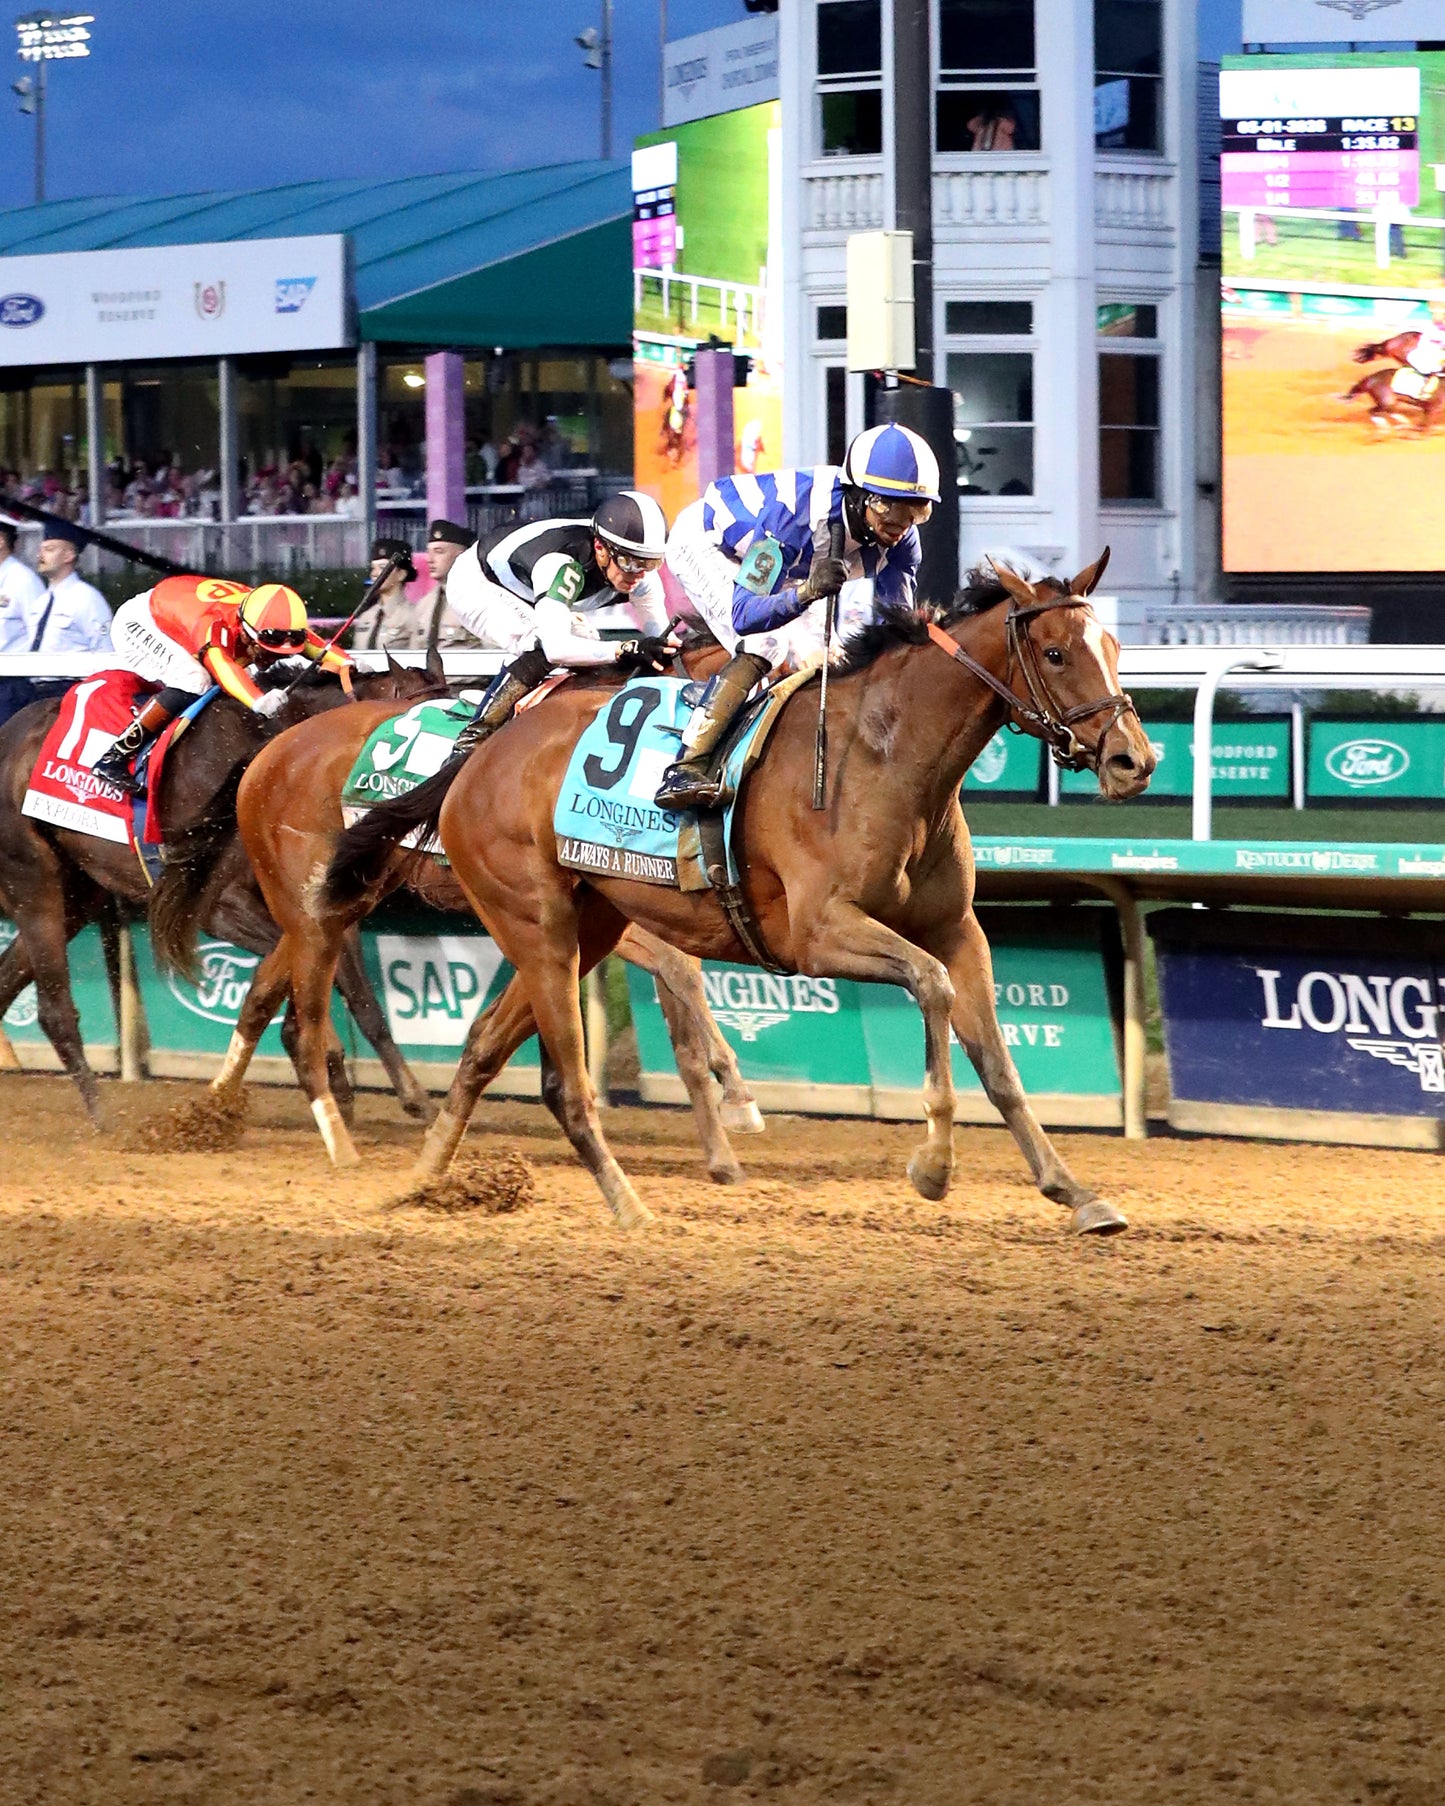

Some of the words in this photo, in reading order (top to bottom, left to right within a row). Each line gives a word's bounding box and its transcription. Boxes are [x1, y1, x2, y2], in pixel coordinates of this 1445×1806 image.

[1341, 118, 1389, 133] RACE
[1390, 117, 1415, 131] 13
[1256, 138, 1297, 151] MILE
[557, 566, 581, 600] 5
[746, 551, 776, 586] 9
[56, 679, 107, 760] 1
[371, 699, 460, 771] 5
[583, 686, 662, 790] 9
[1188, 745, 1278, 759] ODFORD
[1211, 766, 1270, 780] ESERVE
[1340, 745, 1394, 776] Ford
[41, 760, 124, 803] LONGINES
[354, 773, 421, 795] LONG
[32, 796, 100, 831] EXPLORA
[569, 793, 678, 833] LONGINES
[561, 839, 610, 870] ALWAYS
[612, 854, 621, 872] A
[624, 855, 676, 881] RUNNER
[1235, 850, 1311, 869] KENTUCKY
[1330, 851, 1380, 870] DERBY
[1397, 853, 1445, 876] twinsp
[387, 960, 478, 1019] SAP
[653, 970, 840, 1014] NGINES
